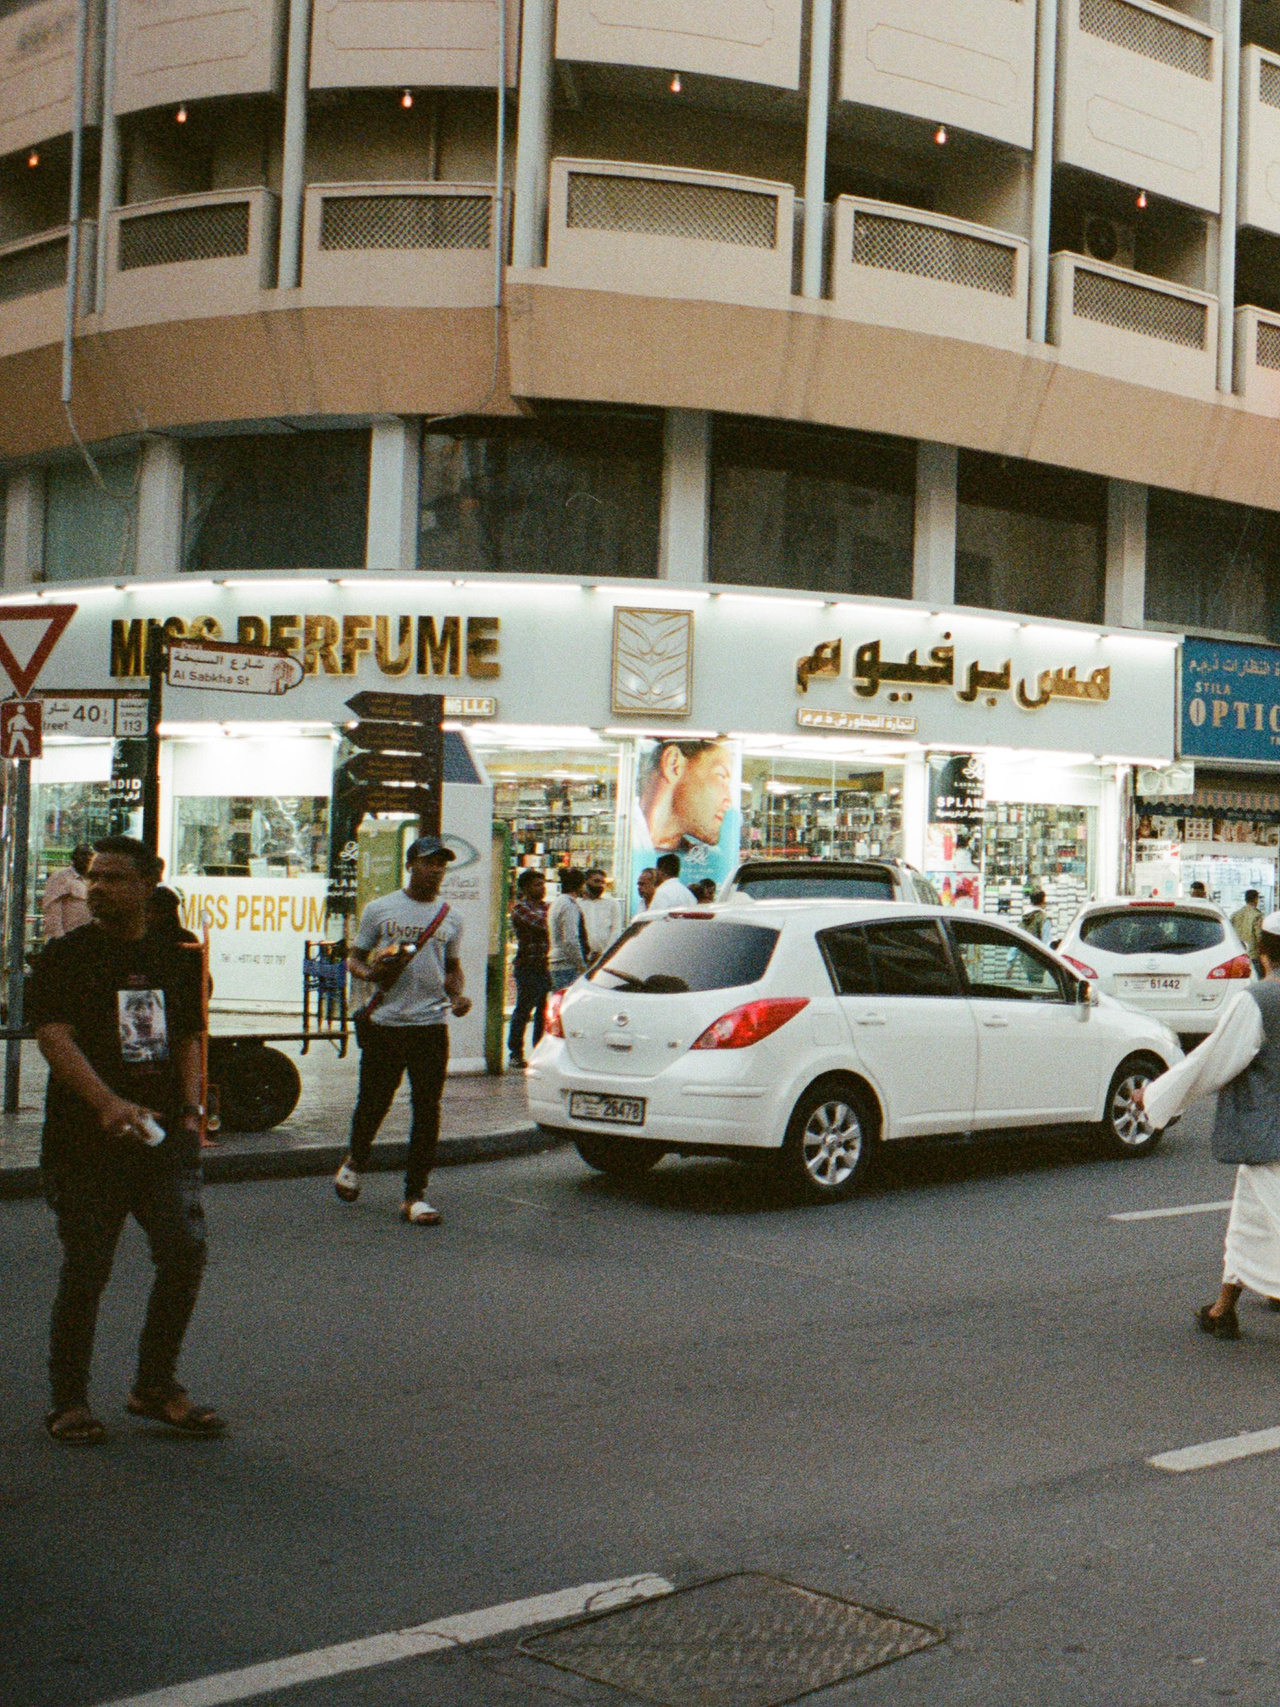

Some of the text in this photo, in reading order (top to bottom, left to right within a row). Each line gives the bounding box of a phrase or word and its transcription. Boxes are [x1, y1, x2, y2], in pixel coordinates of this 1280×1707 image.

[230, 658, 265, 671] شارع
[173, 670, 250, 685] Al Sabkha St
[1194, 681, 1232, 696] STILA
[73, 704, 101, 723] 40
[465, 697, 493, 715] LLC
[123, 719, 142, 732] 113
[183, 893, 229, 931] MISS
[1149, 978, 1180, 990] 61442
[603, 1100, 641, 1120] 26478
